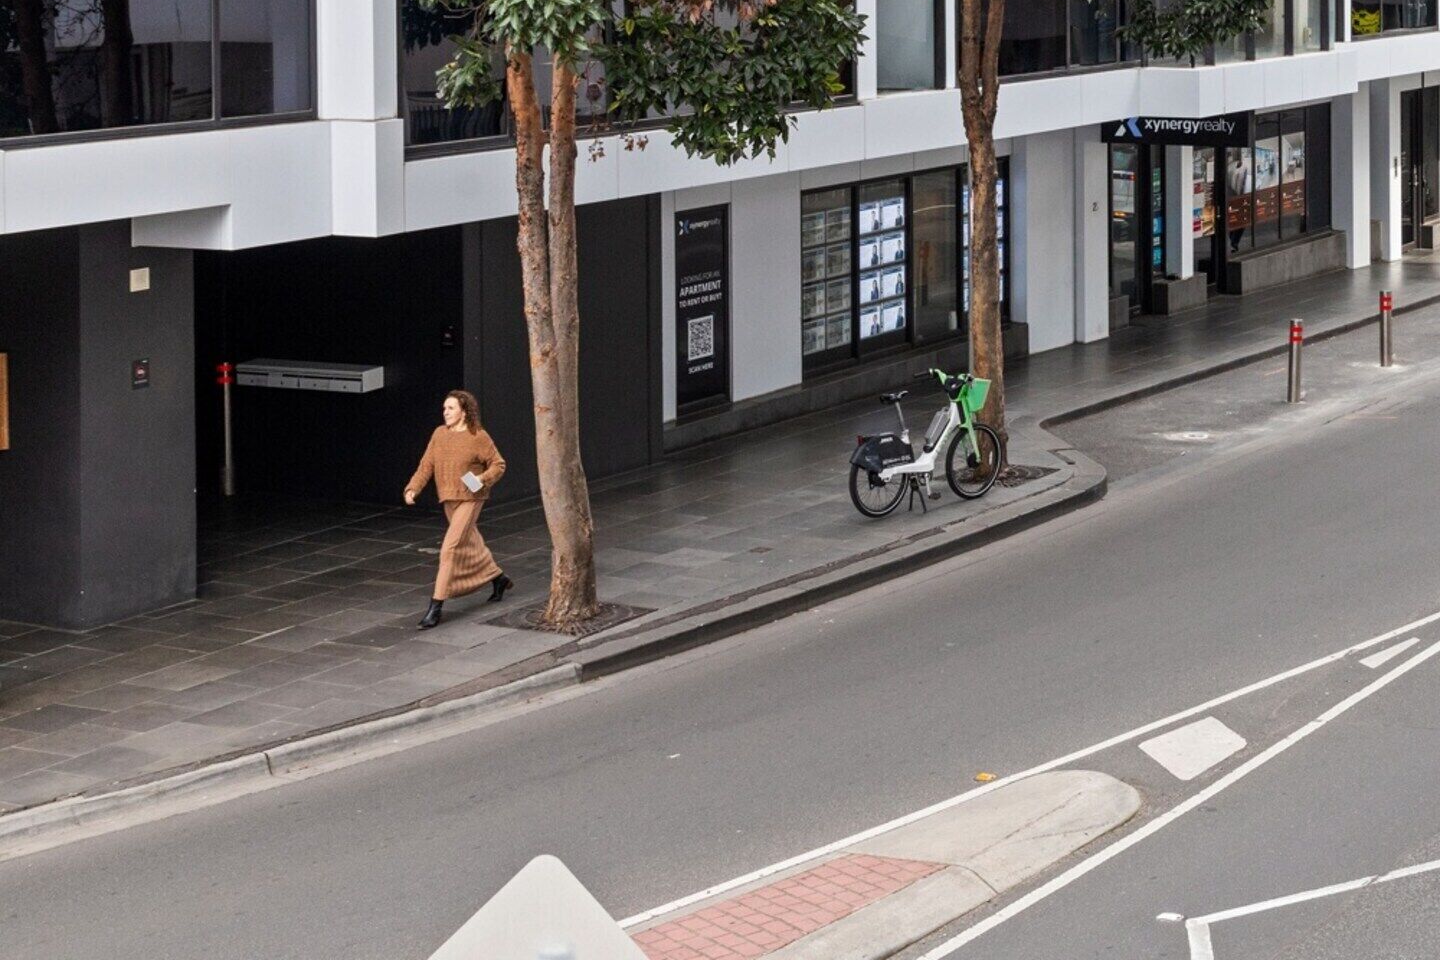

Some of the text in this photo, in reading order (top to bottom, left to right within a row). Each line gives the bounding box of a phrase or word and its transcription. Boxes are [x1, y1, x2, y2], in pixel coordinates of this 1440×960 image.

[1144, 118, 1236, 134] xynergyrealty
[679, 279, 722, 297] APARTMENT
[679, 300, 687, 308] TO
[687, 297, 701, 305] RENT
[701, 295, 709, 303] OR
